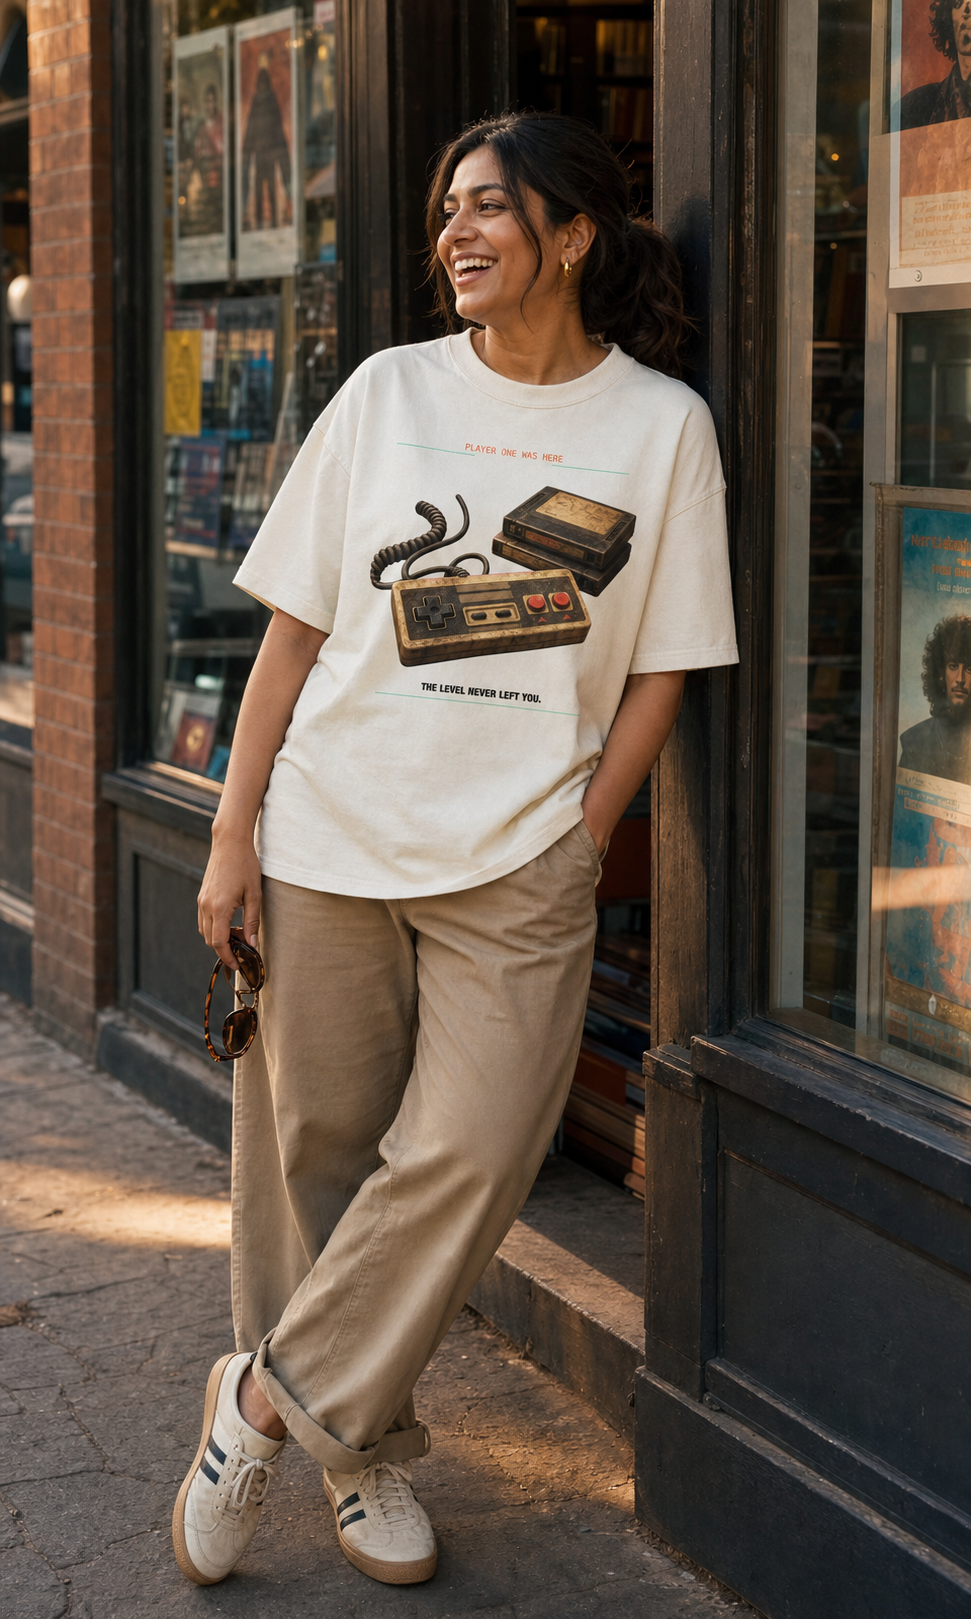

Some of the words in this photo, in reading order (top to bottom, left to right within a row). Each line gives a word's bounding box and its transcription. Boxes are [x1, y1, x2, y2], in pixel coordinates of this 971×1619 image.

[465, 443, 497, 455] PLAYER
[501, 448, 517, 457] ONE
[521, 451, 538, 460] WAS
[542, 453, 563, 463] HERE
[421, 682, 438, 692] THE
[440, 684, 465, 695] LEVEL
[467, 687, 496, 698] NEVER
[499, 690, 520, 700] LEFT
[522, 693, 541, 704] YOU.
